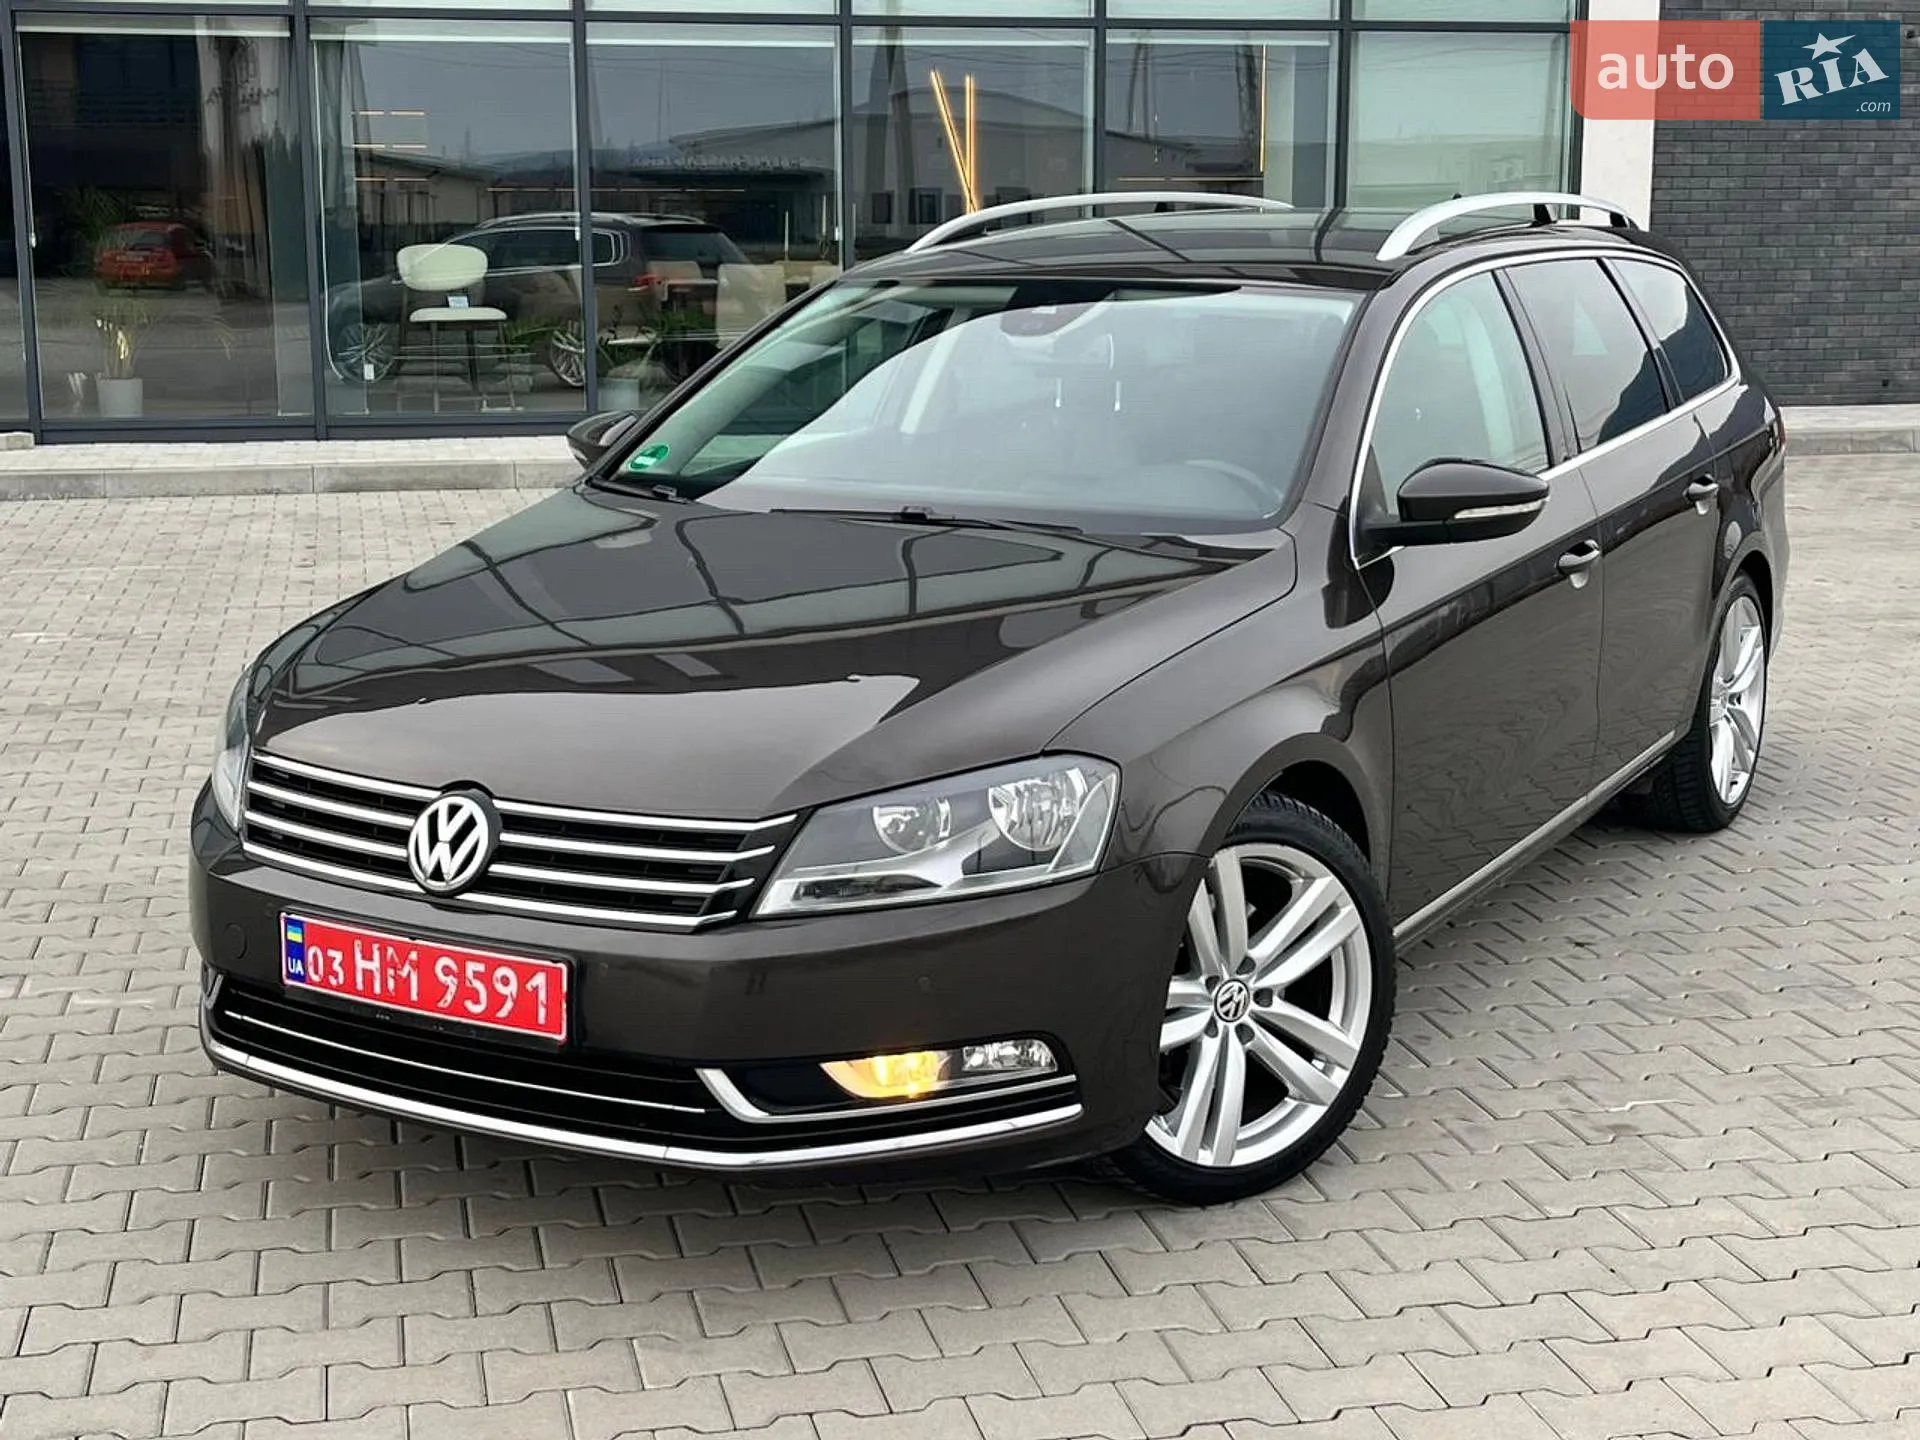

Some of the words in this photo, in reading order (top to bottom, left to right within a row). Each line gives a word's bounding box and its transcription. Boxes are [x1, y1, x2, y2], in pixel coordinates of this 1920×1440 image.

[287, 956, 304, 977] UA
[307, 945, 345, 986] 03
[353, 938, 419, 1002] HM
[434, 955, 548, 1025] 9591
